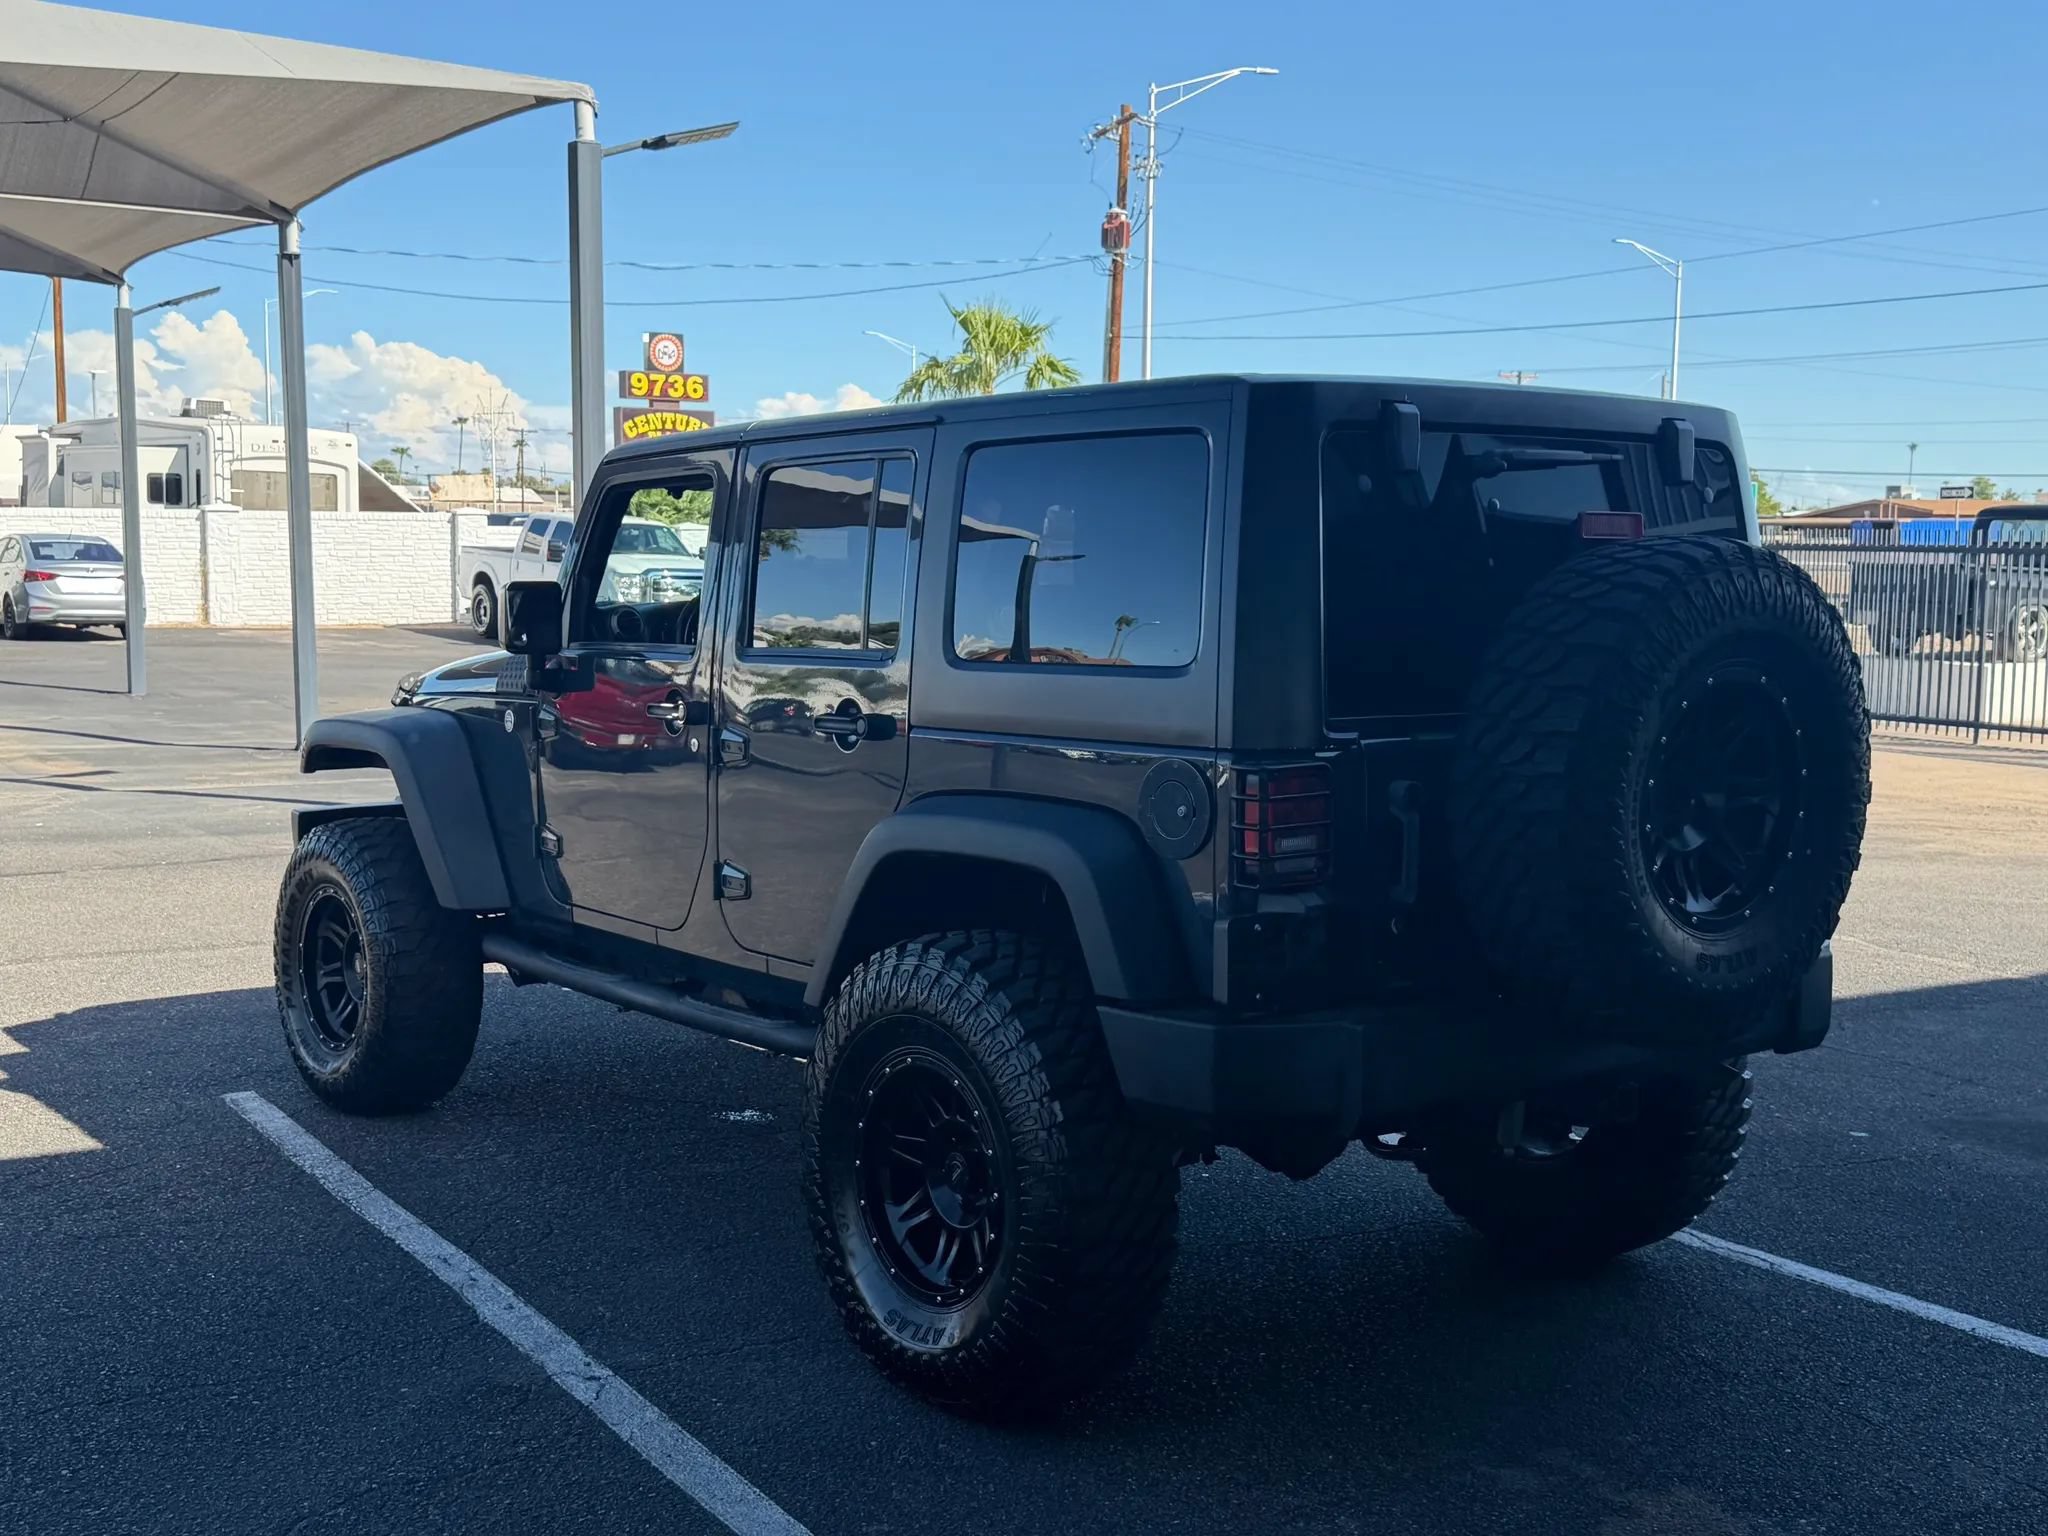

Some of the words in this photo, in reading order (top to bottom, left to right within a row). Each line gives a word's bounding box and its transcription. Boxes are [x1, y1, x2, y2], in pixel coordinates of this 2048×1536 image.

[630, 372, 704, 399] 9736
[250, 443, 319, 456] DESIR
[1696, 946, 1758, 974] ATLAS
[883, 1308, 947, 1346] ATLAS
